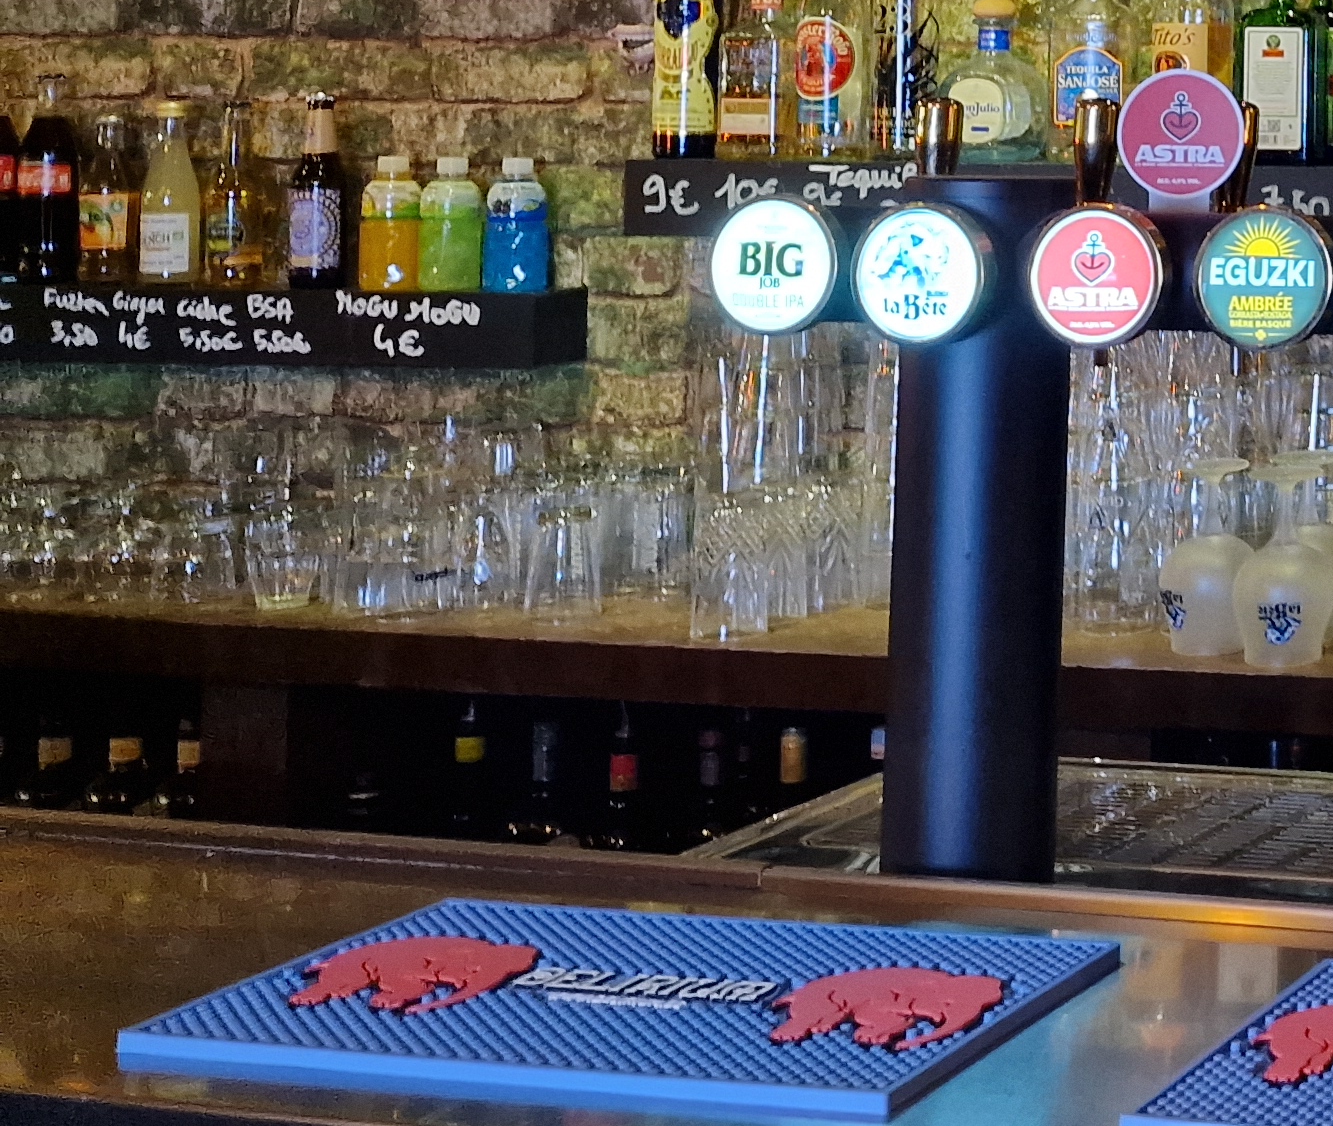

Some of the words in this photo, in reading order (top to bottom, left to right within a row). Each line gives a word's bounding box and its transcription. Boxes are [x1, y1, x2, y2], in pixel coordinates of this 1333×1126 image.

[1151, 27, 1196, 47] Tito's
[1066, 64, 1109, 74] TEQUILA
[1135, 145, 1225, 163] ASTRA
[643, 173, 700, 216] 9€
[738, 240, 804, 278] BIG
[1209, 257, 1316, 287] EGUZKI
[759, 276, 781, 290] JOB
[785, 295, 804, 308] IPA
[883, 298, 900, 314] la
[1047, 286, 1139, 308] ASTRA
[1228, 291, 1294, 311] AMBRÉE
[247, 293, 294, 324] BSA
[1255, 319, 1292, 329] BASQUE
[373, 329, 425, 358] 4€
[513, 967, 778, 1003] DELIRIUM
